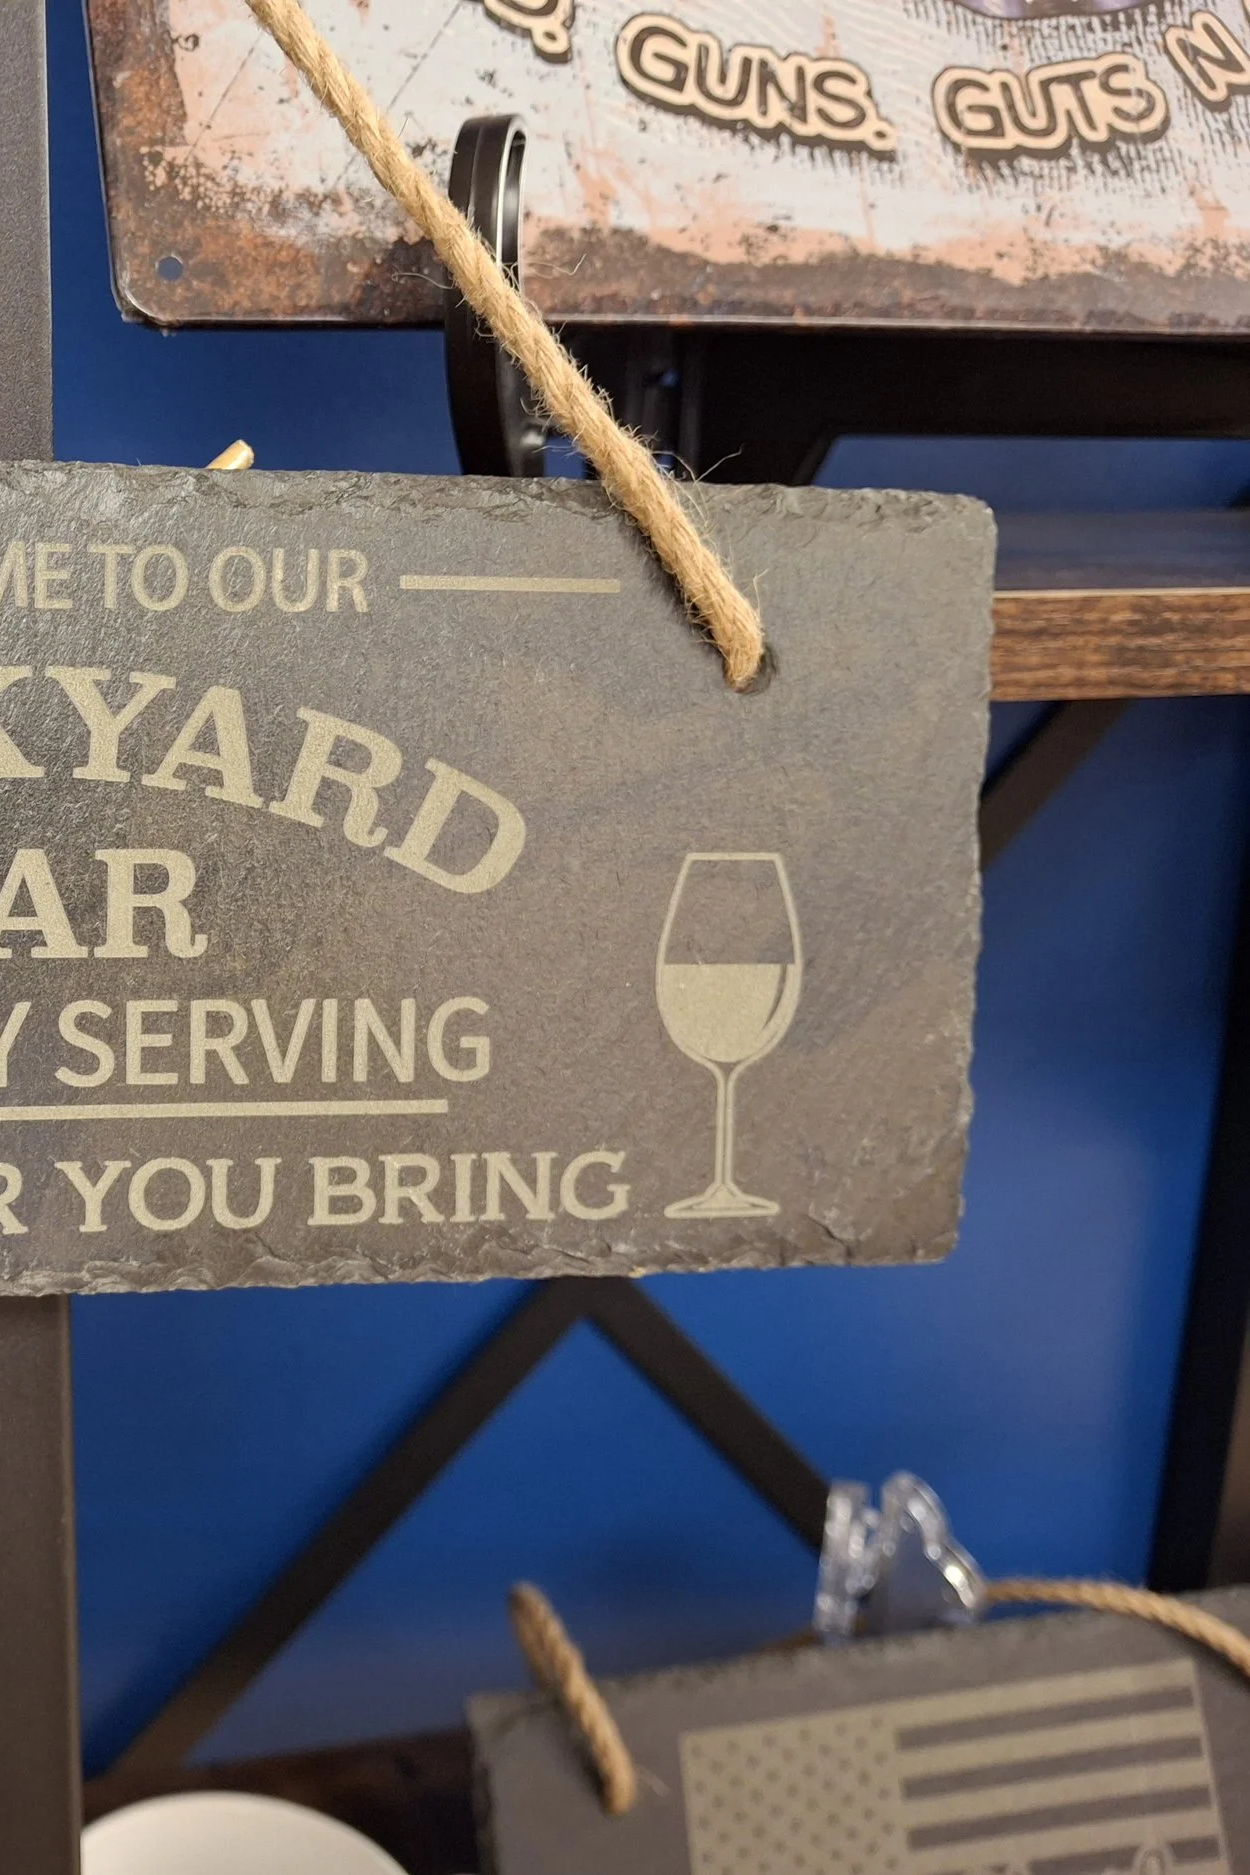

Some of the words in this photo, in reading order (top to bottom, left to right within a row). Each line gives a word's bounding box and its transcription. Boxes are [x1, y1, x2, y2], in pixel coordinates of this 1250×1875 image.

[618, 14, 896, 150] GUNS.
[933, 53, 1166, 149] GUTS
[87, 543, 190, 613] TO
[208, 546, 370, 614] OUR
[55, 996, 492, 1087] SERVING
[54, 1156, 282, 1233] YOU
[308, 1150, 632, 1226] BRING
